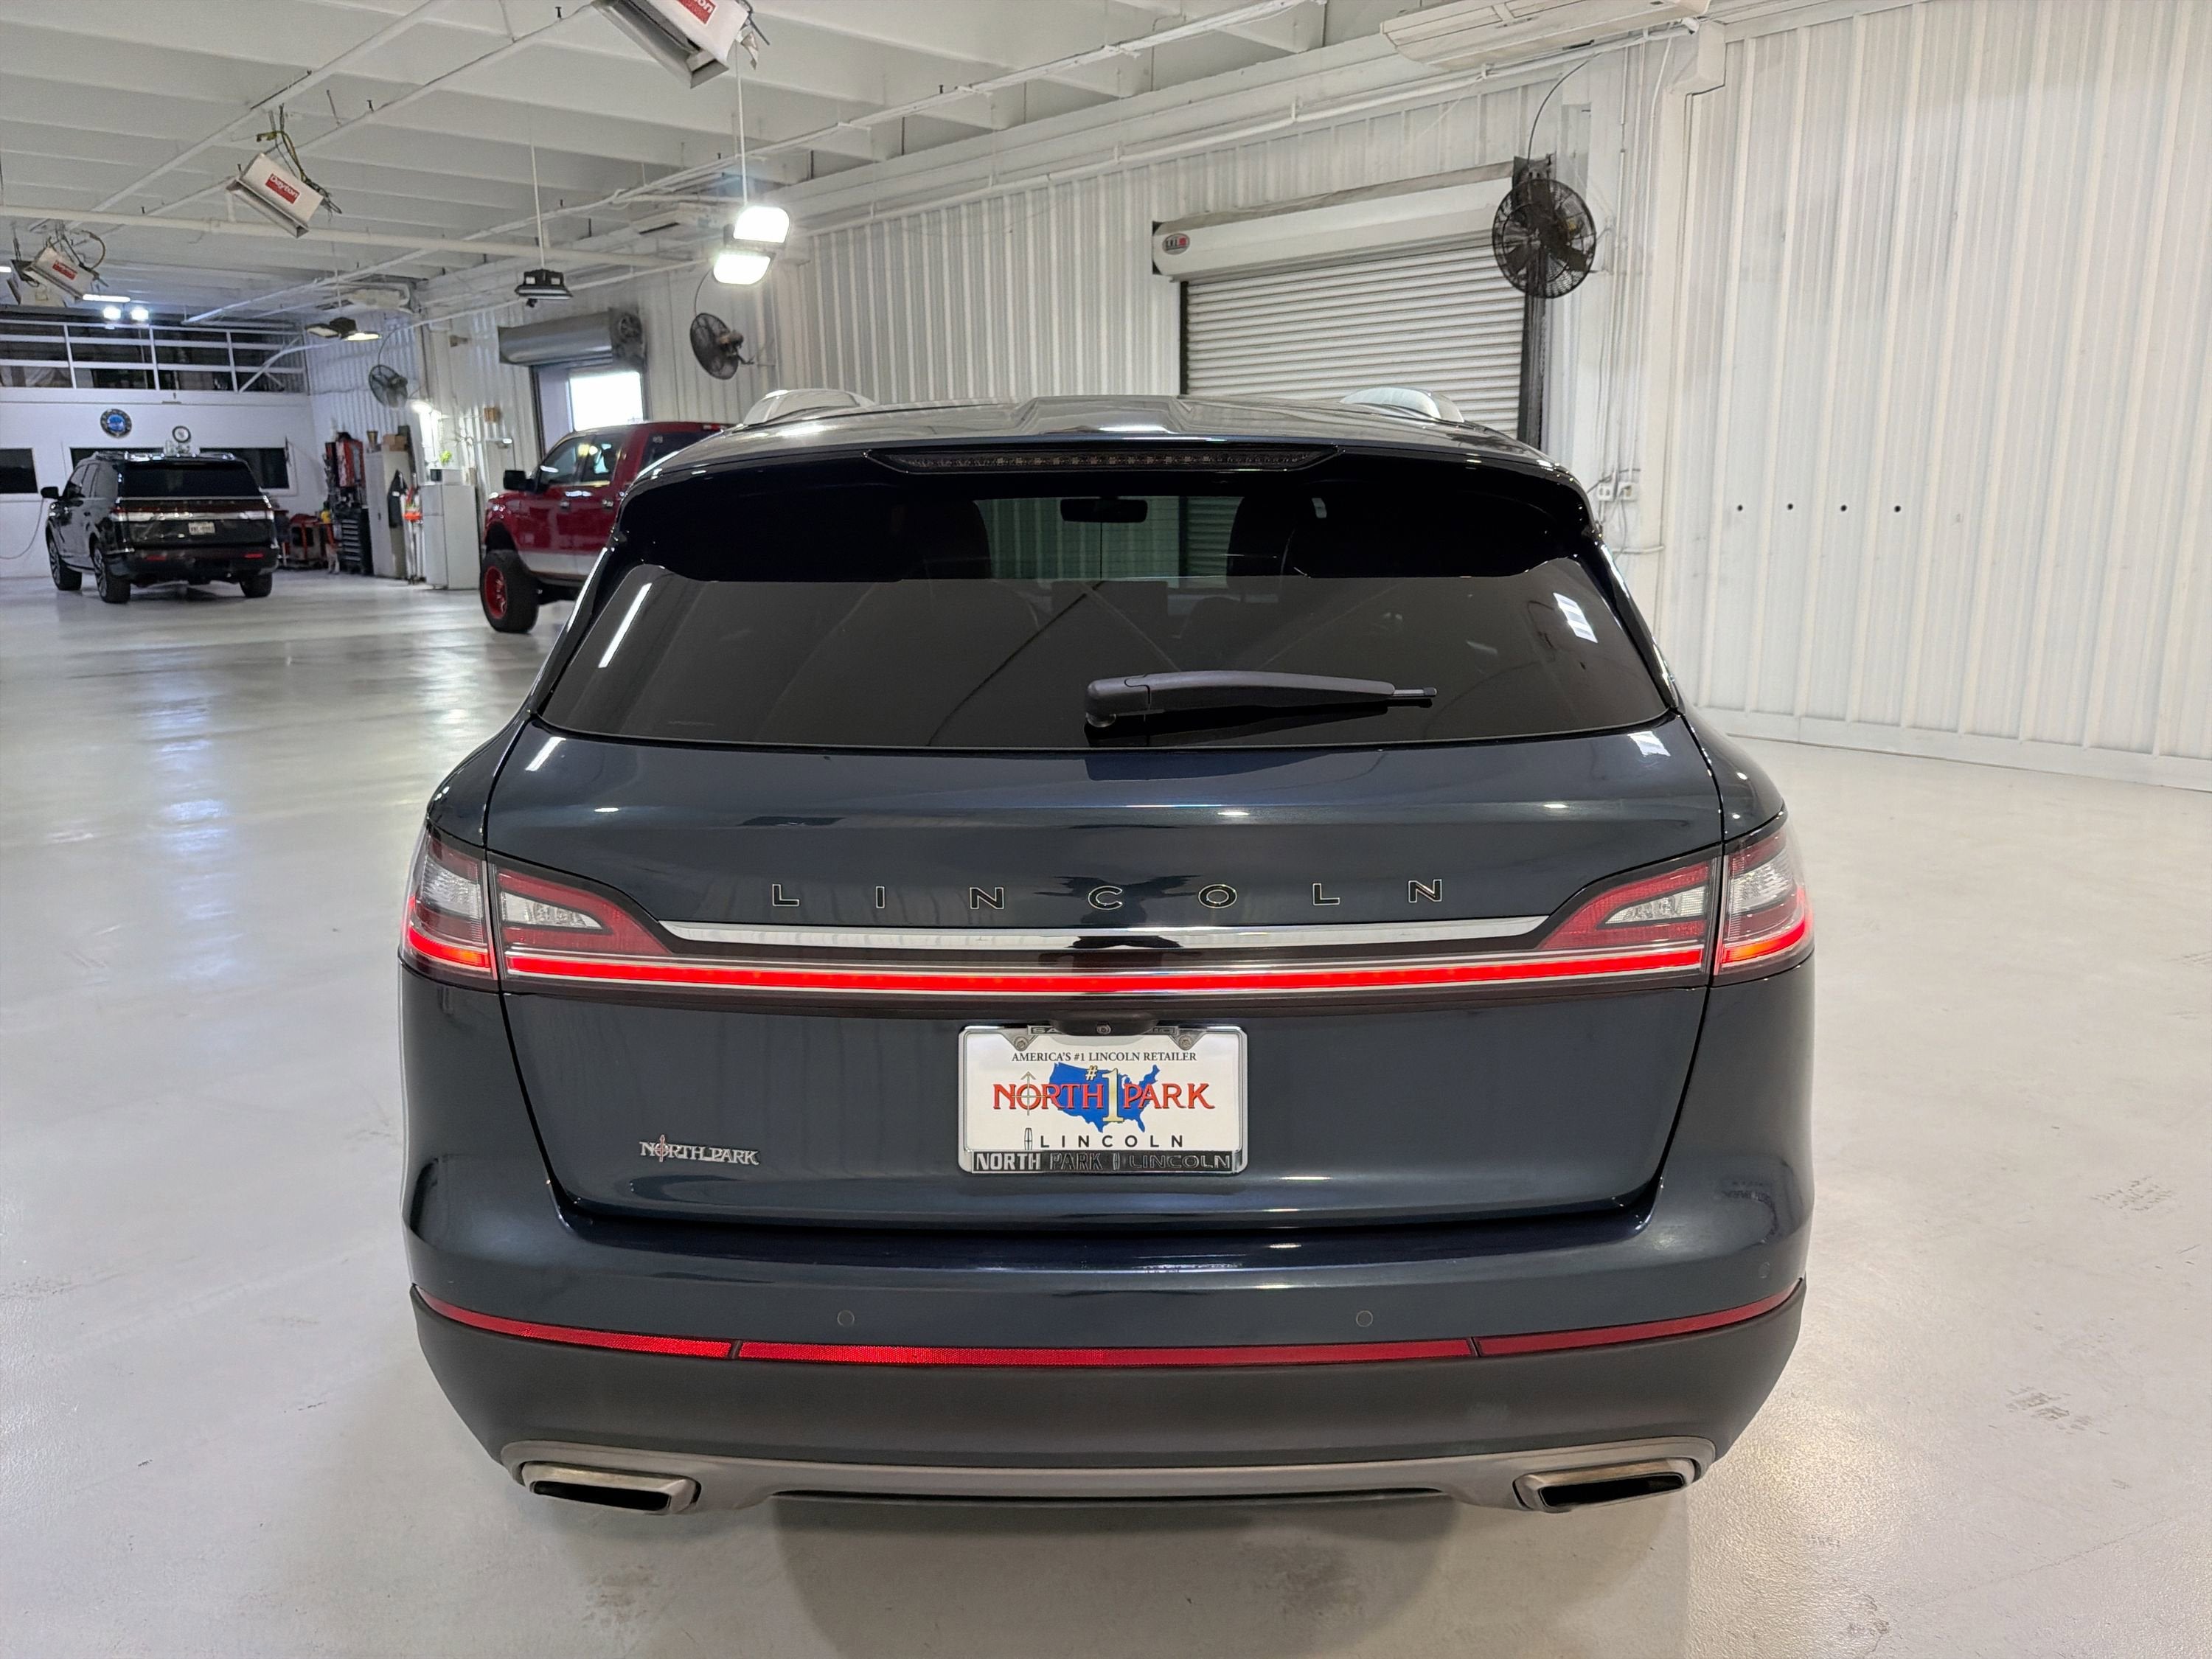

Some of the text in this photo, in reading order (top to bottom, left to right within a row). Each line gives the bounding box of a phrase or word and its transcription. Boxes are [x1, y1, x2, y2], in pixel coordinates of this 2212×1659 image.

[270, 175, 299, 198] Dayton
[772, 879, 1442, 910] LINCOLN
[1012, 1051, 1197, 1062] AMERICA'S #1 LINCOLN RETAILER
[992, 1083, 1215, 1110] NORTH PARK
[639, 1141, 759, 1165] NORTH PARK
[1040, 1135, 1183, 1148] LINCOLN
[976, 1152, 1230, 1171] NORTH PARK LINCOLN
